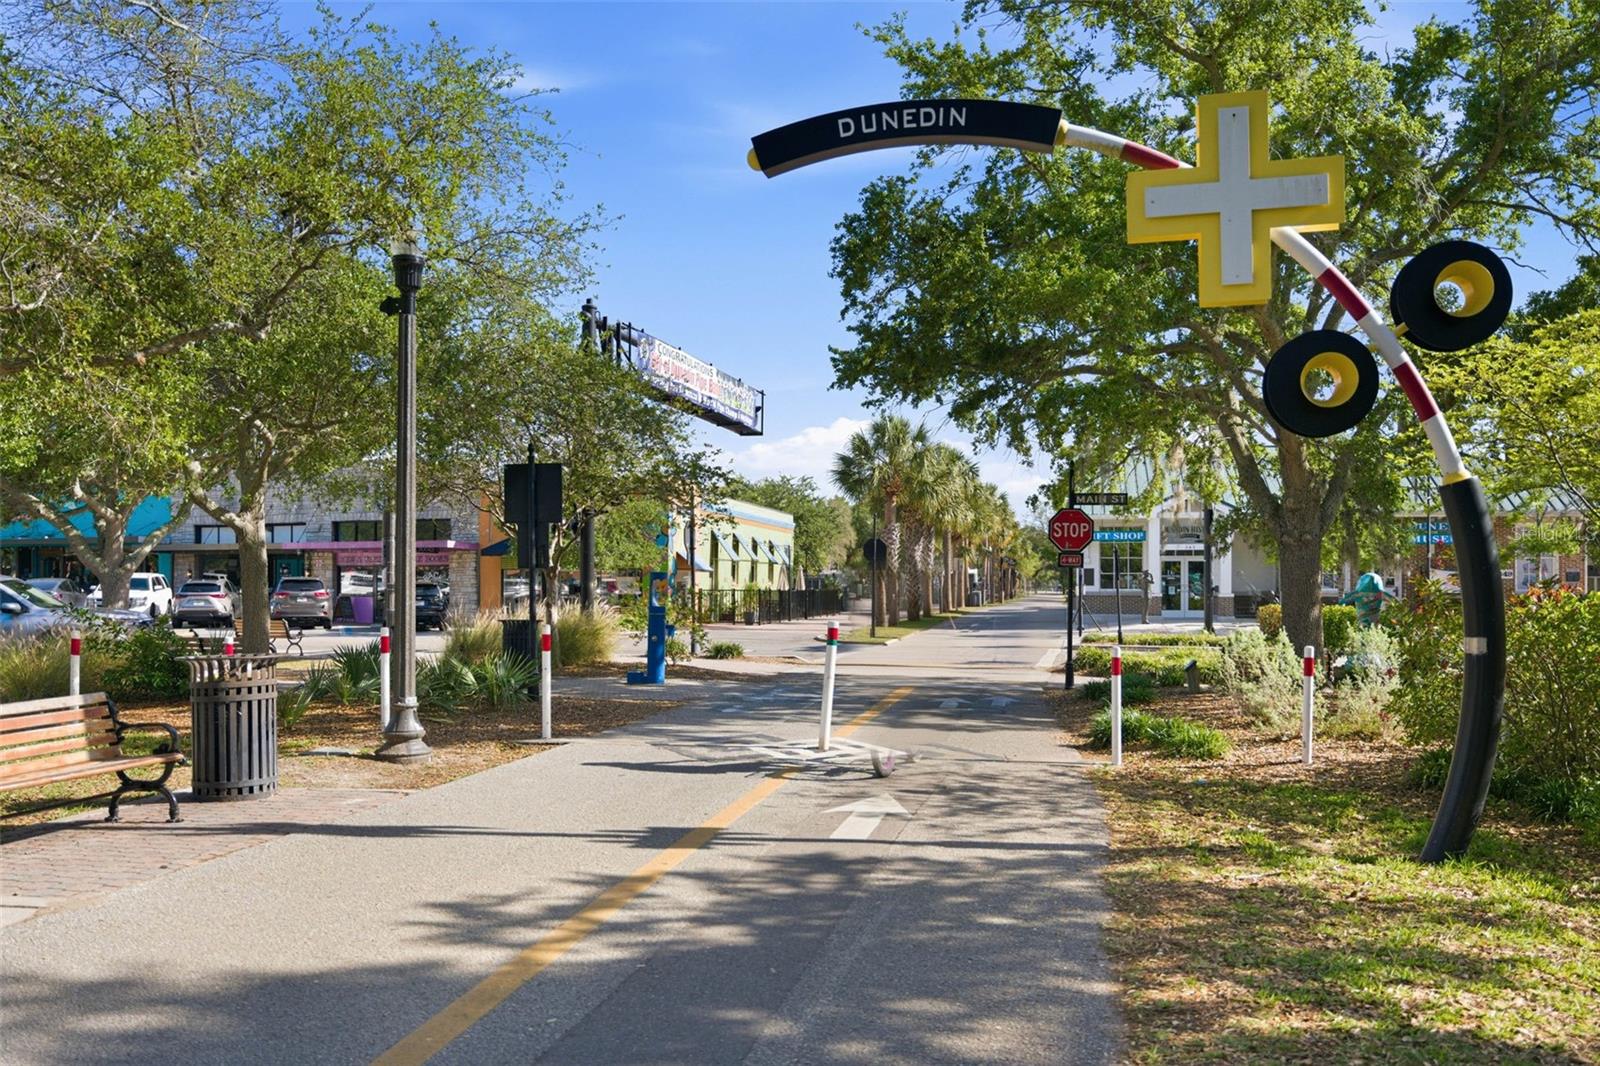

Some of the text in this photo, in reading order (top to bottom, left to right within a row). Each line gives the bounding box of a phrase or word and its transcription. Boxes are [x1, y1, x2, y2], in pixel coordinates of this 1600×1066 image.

[837, 107, 967, 138] DUNEDIN
[657, 342, 714, 378] CONGRATULATIONS
[1076, 495, 1125, 503] MAIN ST
[1053, 522, 1089, 538] STOP
[1093, 532, 1144, 540] IFT SHOP
